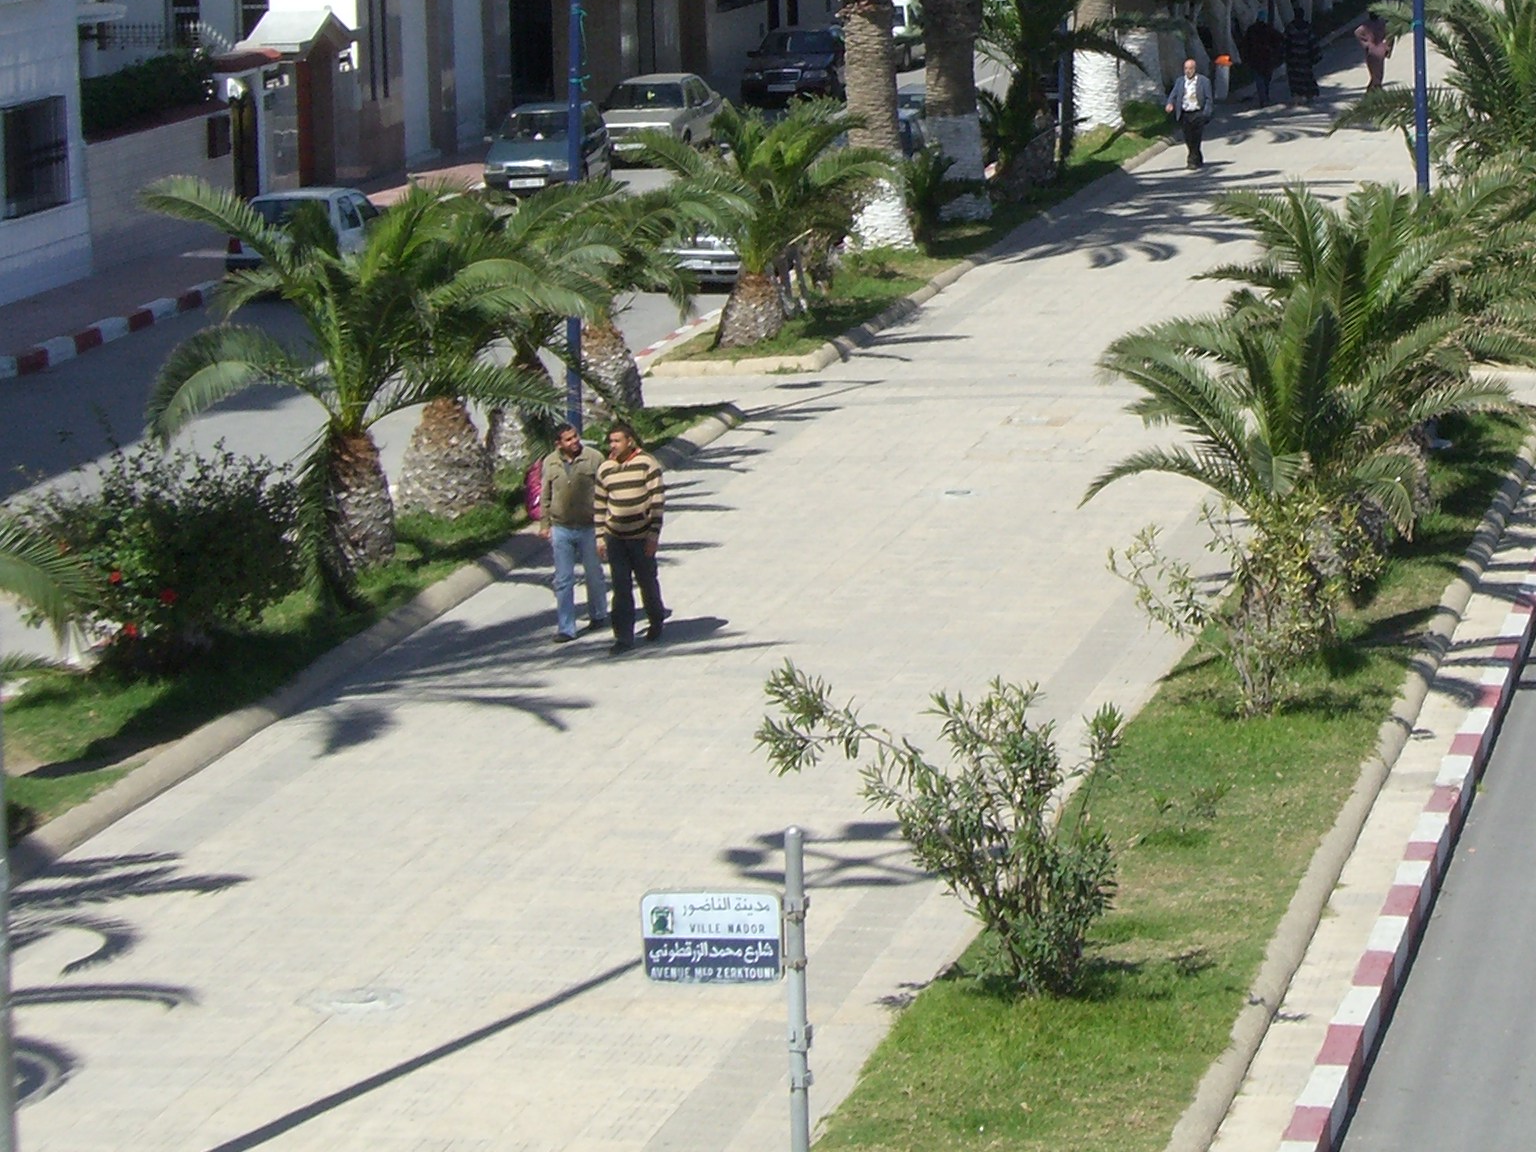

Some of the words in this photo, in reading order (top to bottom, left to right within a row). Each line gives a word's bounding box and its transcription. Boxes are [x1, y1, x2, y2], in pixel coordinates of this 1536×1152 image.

[682, 896, 731, 916] الناضور
[735, 897, 770, 916] مدينة
[690, 923, 721, 934] VILLE
[728, 923, 766, 934] NADOR
[648, 941, 708, 963] الزرقطوني
[709, 944, 743, 958] محمد
[743, 941, 774, 963] شارع
[650, 966, 691, 978] AVENUE
[716, 966, 775, 979] ZERKTOUNI
